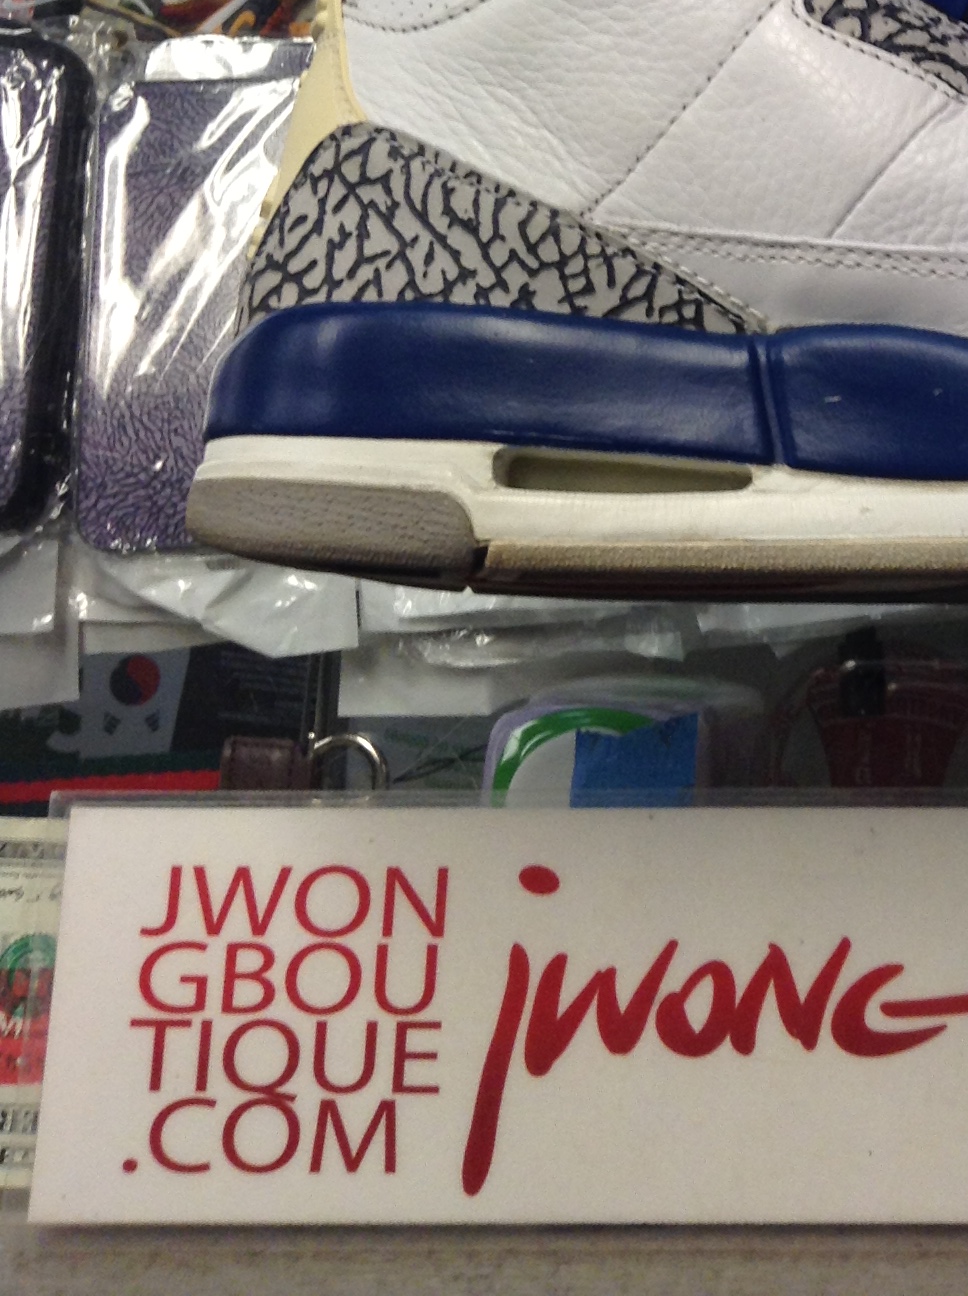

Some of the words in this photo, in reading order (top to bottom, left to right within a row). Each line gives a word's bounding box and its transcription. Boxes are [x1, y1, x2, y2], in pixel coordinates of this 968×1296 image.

[139, 864, 449, 938] JWON
[138, 941, 439, 1015] GBOU
[129, 1018, 442, 1101] TIQUE
[122, 1097, 397, 1174] .COM
